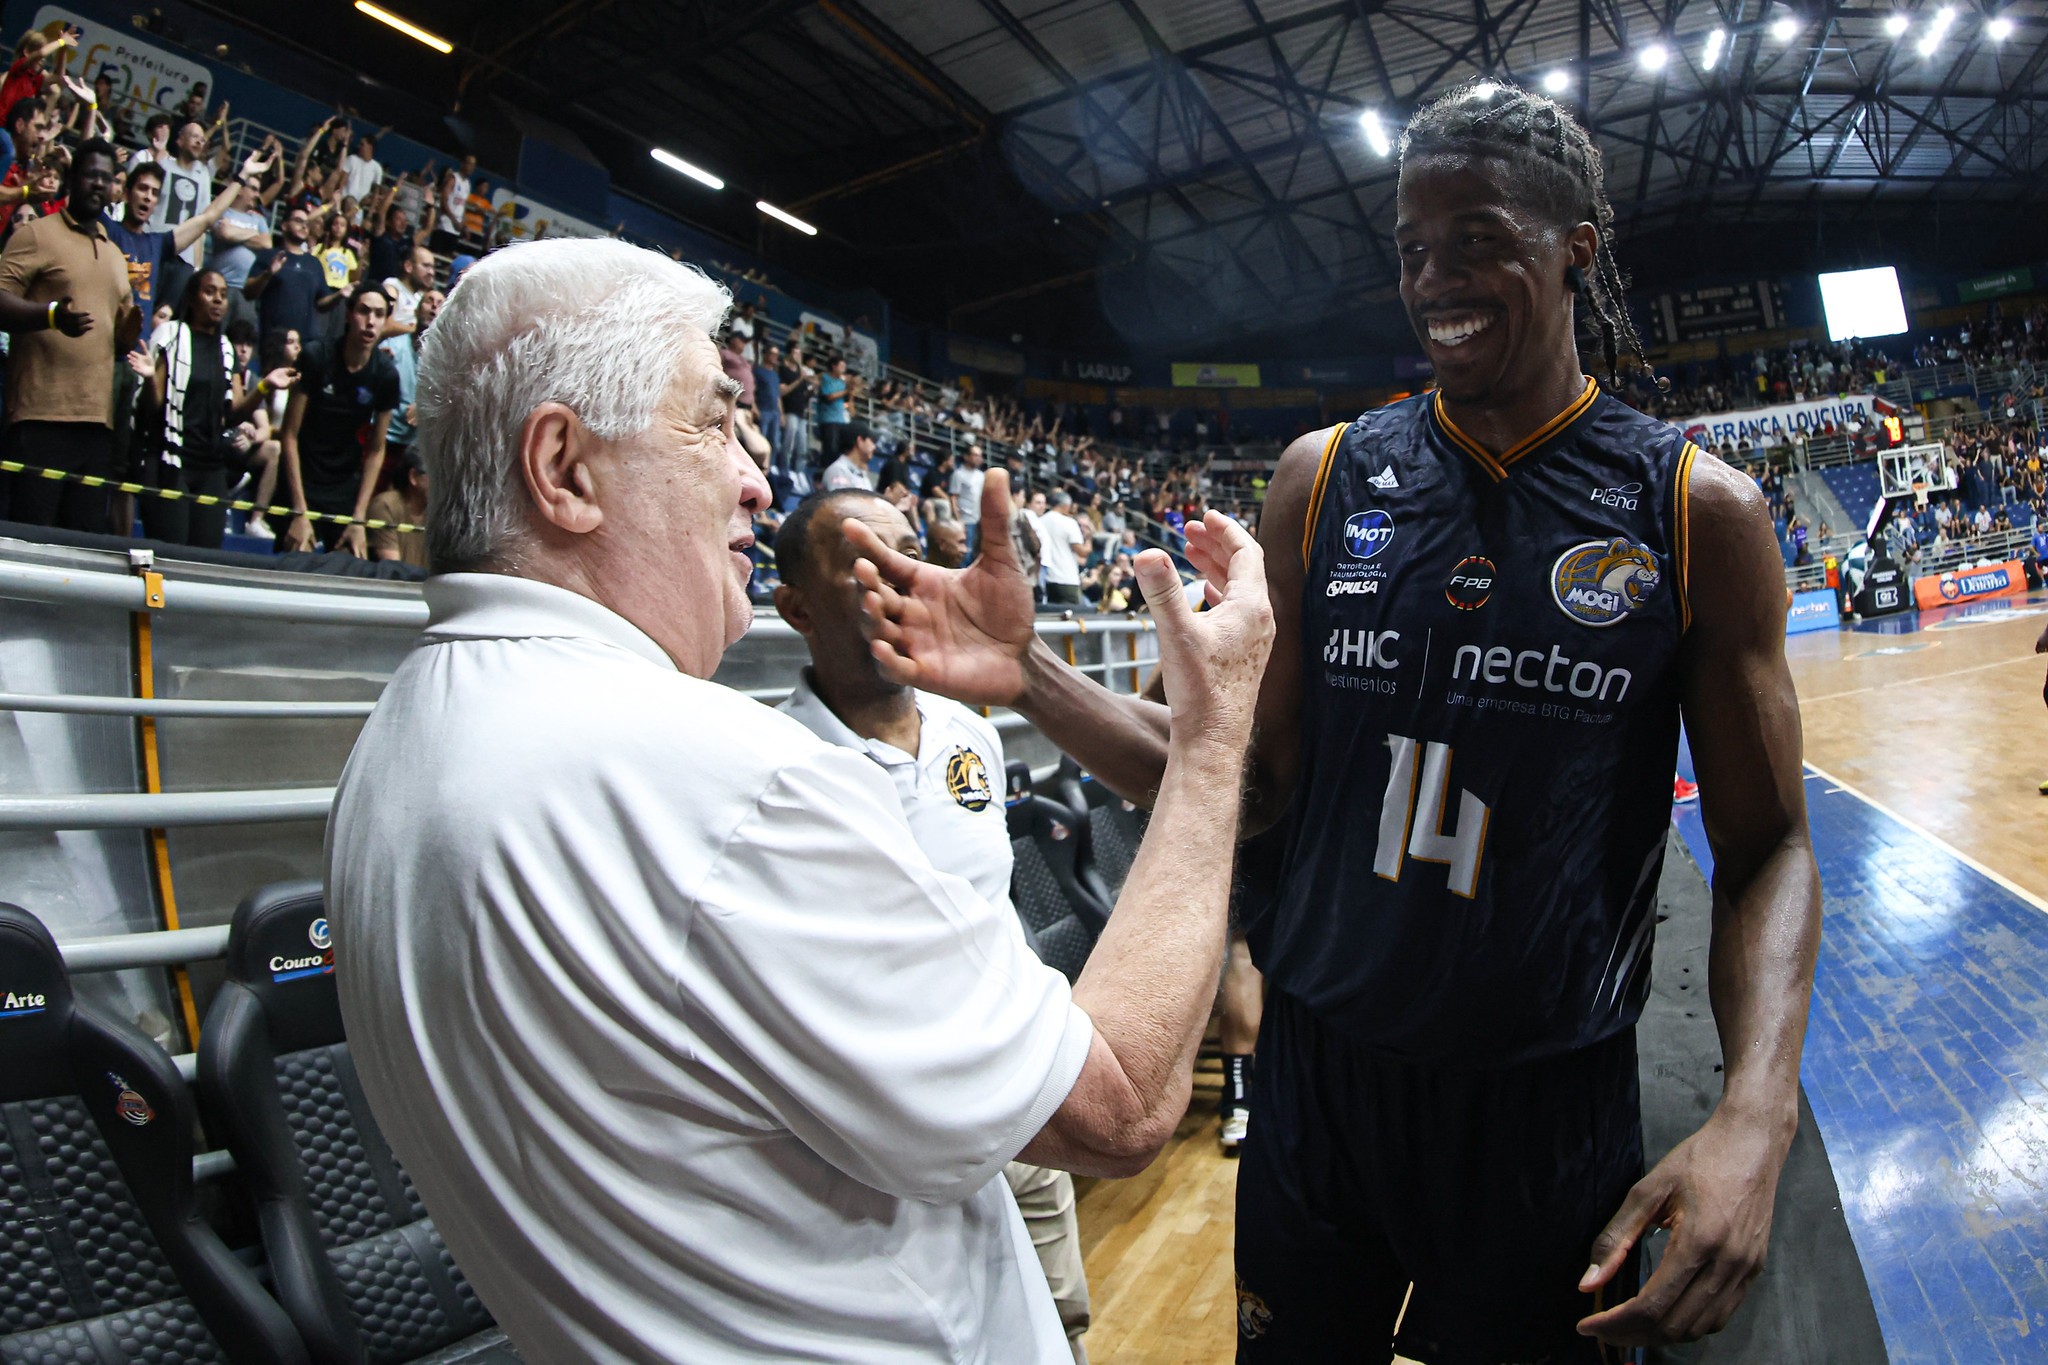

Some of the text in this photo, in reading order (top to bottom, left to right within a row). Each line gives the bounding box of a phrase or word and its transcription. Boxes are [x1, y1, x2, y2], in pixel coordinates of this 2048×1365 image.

[115, 46, 190, 84] Prefeitura
[1590, 487, 1638, 511] Plena
[1345, 523, 1392, 541] IMOT
[1339, 580, 1379, 594] PULSA
[1449, 575, 1492, 589] FPB
[1961, 574, 2007, 594] Daiana
[1565, 587, 1620, 612] MOGI
[1341, 629, 1401, 669] HIC
[1452, 644, 1632, 702] necton
[1446, 691, 1473, 706] Uma
[1477, 697, 1536, 716] empresa
[1541, 703, 1570, 720] BTG
[1373, 733, 1491, 899] 14
[269, 955, 323, 972] Couro
